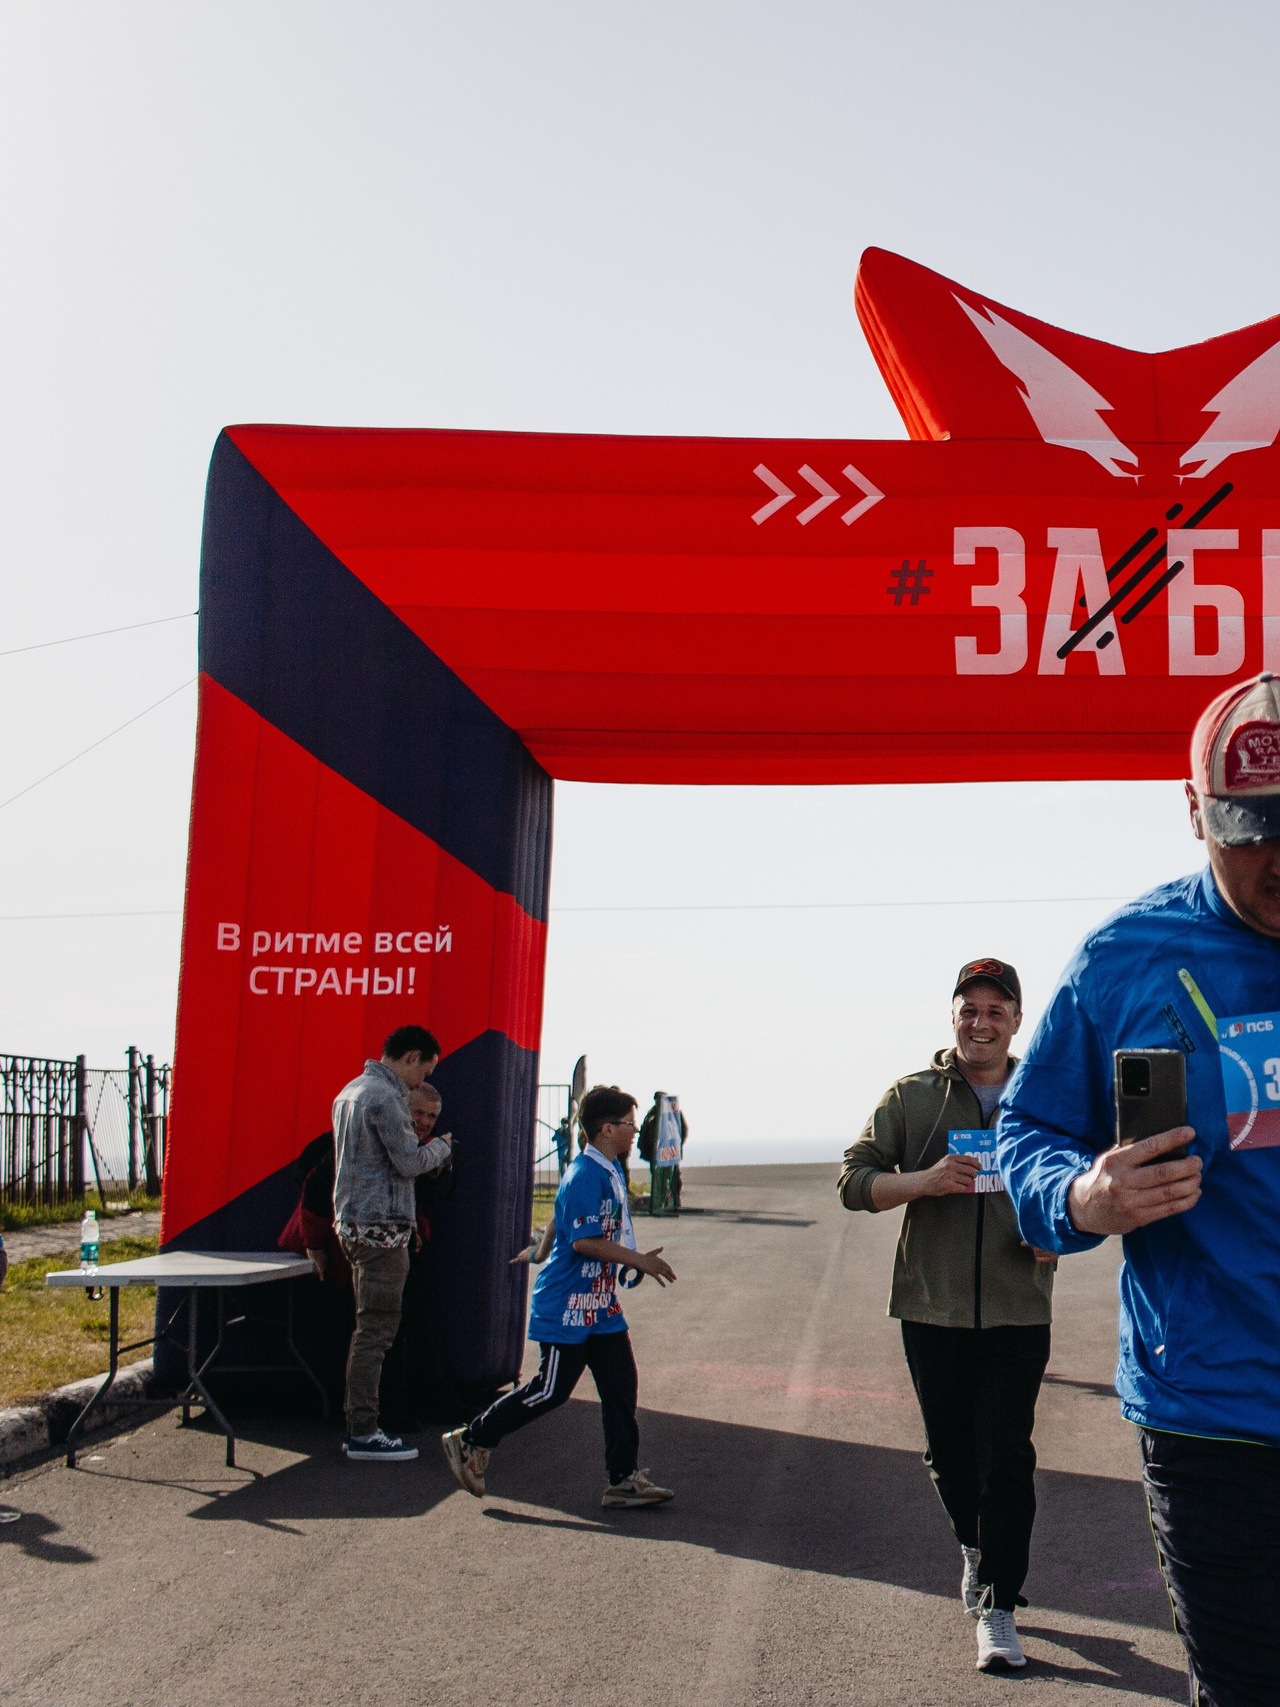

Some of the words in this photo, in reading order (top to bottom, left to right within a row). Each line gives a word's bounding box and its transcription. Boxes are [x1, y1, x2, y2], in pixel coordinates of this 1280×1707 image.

[216, 922, 241, 950] В
[252, 930, 363, 957] ритме
[374, 924, 453, 953] всей
[249, 965, 417, 996] СТРАНЫ!
[1246, 1020, 1274, 1034] ПСБ
